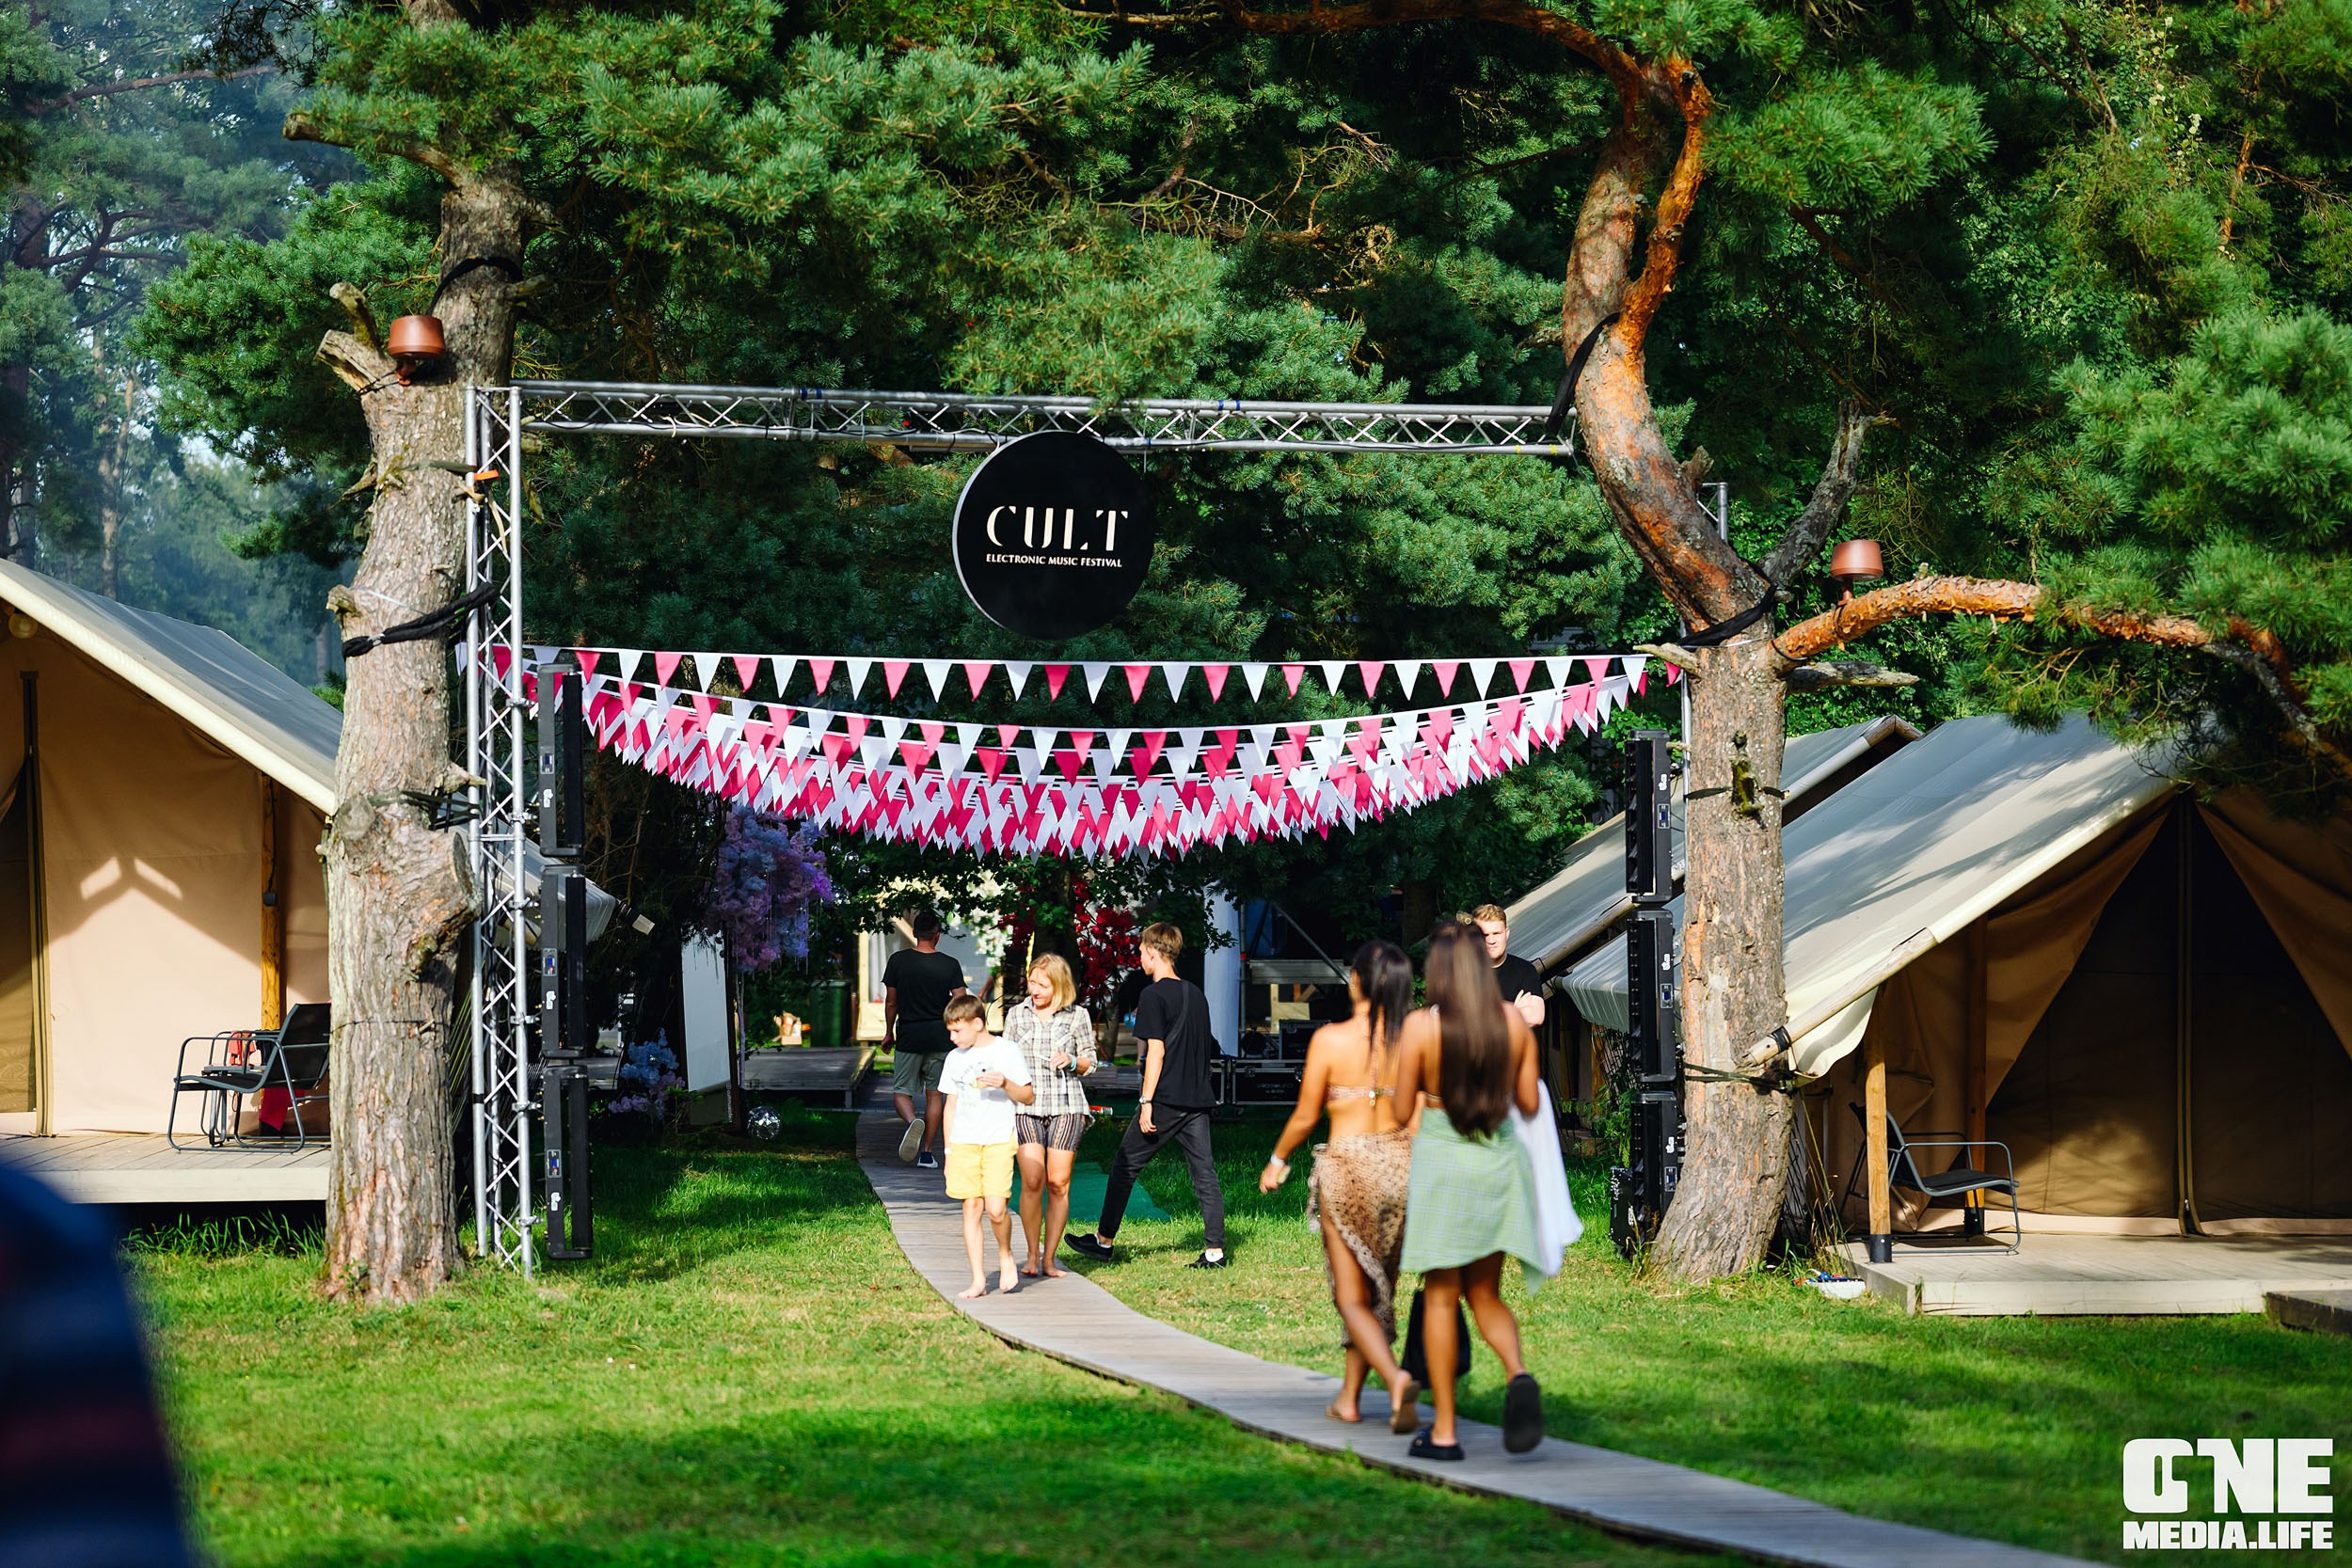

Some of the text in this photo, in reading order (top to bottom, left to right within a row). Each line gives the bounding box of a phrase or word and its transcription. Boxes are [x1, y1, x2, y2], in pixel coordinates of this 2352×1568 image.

[986, 505, 1129, 551] CULT
[986, 553, 1123, 568] ELECTRONIC MUSIC FESTIVAL
